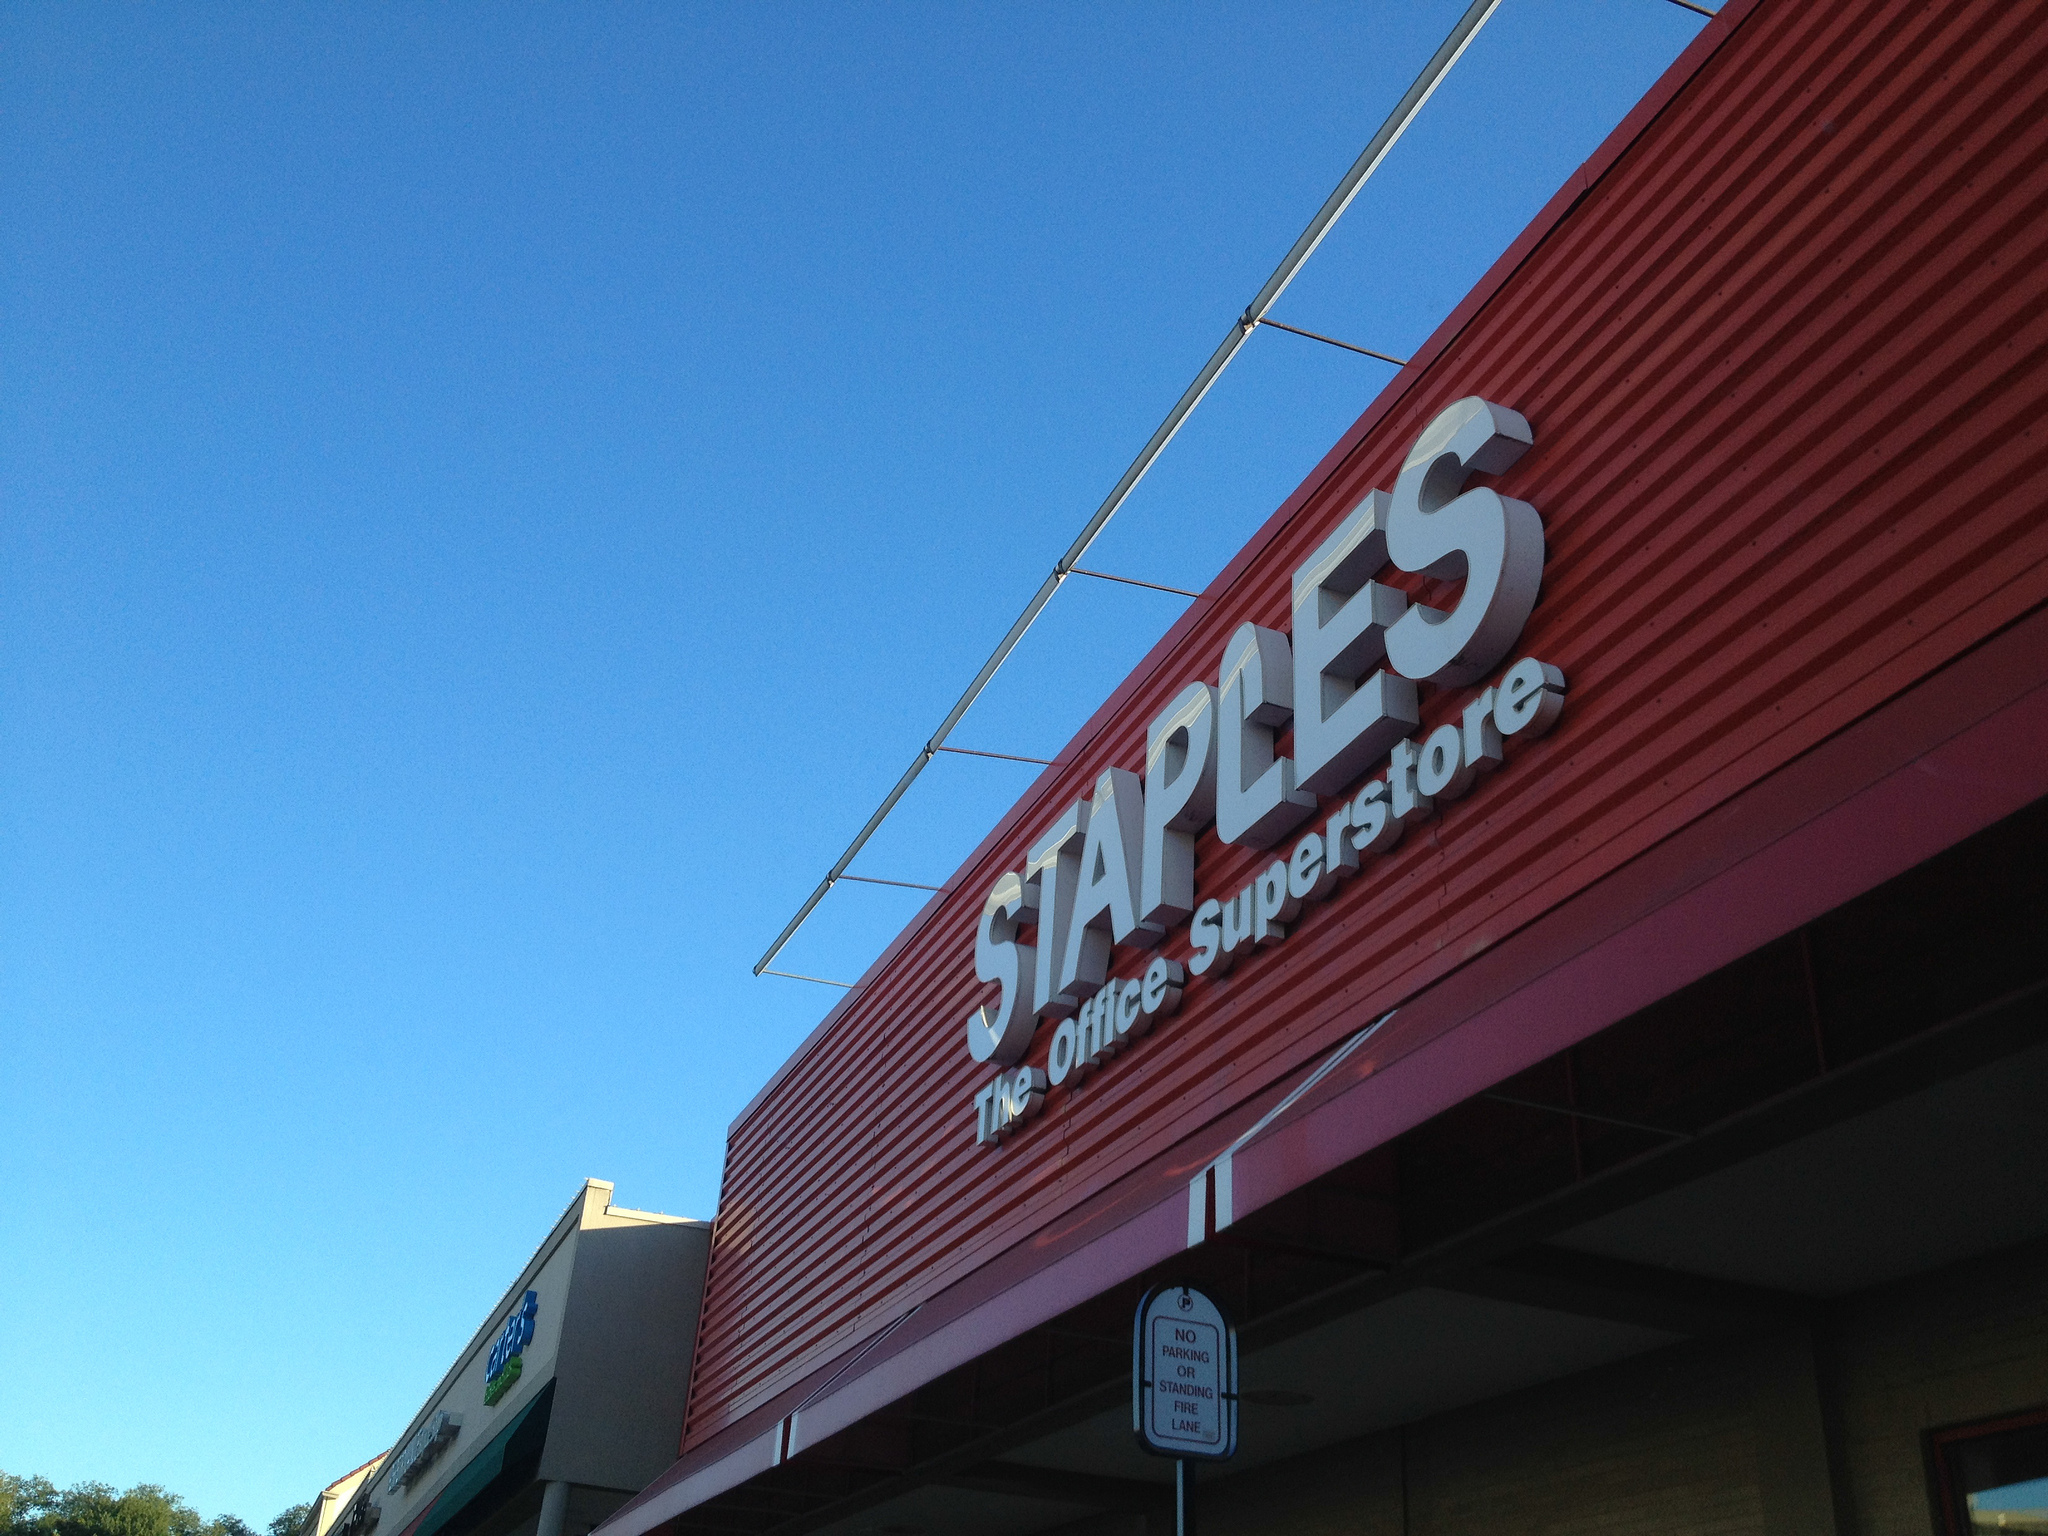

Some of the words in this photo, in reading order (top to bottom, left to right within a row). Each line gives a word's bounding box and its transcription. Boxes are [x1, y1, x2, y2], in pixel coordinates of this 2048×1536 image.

[967, 395, 1542, 1065] STAPLES
[974, 1065, 1042, 1146] The
[1048, 956, 1180, 1087] Office
[1174, 1327, 1197, 1344] NO
[1162, 1344, 1210, 1364] PARKING
[1176, 1365, 1196, 1379] OR
[1159, 1379, 1214, 1400] STANDING
[1174, 1400, 1199, 1415] FIRE
[1171, 1418, 1201, 1433] LANE
